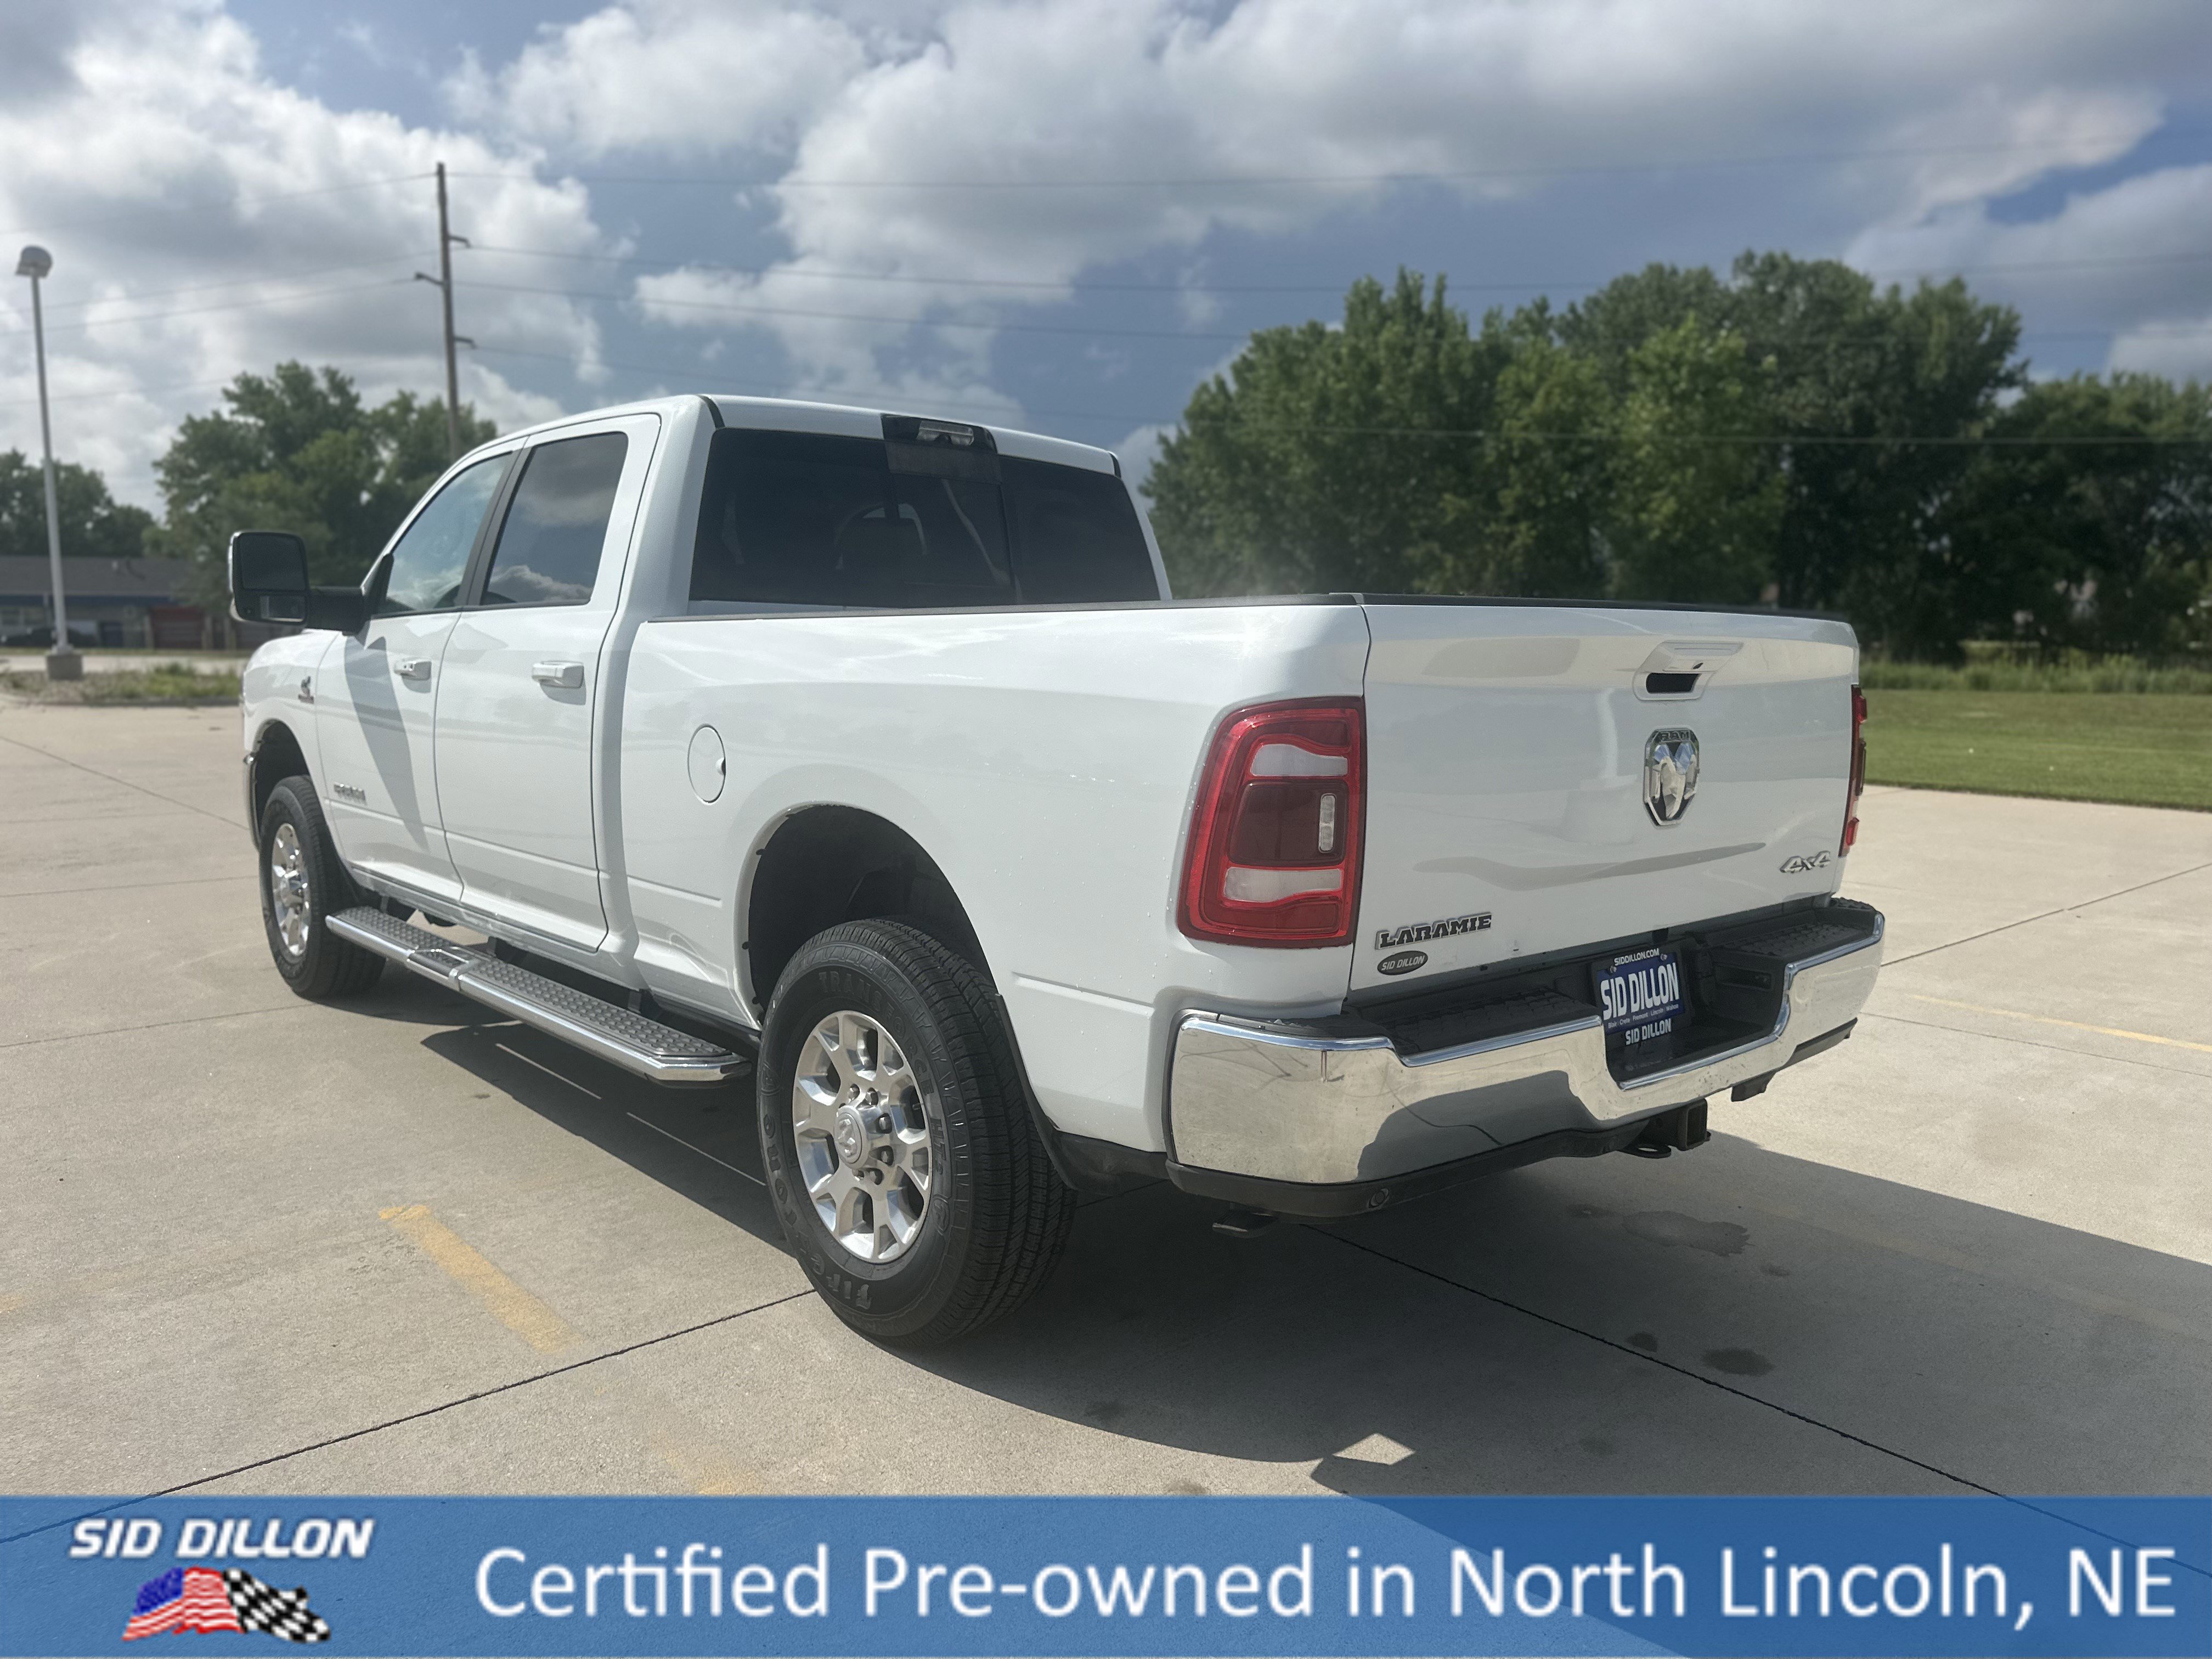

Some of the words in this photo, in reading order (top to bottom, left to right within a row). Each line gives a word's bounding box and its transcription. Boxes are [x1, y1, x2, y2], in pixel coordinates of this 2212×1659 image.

[1659, 731, 1690, 741] RAM
[1375, 912, 1492, 950] LARAMIE
[1381, 961, 1396, 971] SID
[1396, 955, 1425, 969] DILLON
[1613, 947, 1660, 966] SIDDILLON.COM
[1600, 976, 1627, 1021] SID
[1628, 962, 1680, 1013] DILLON
[1624, 1028, 1640, 1046] SID
[1641, 1018, 1672, 1040] DILLON
